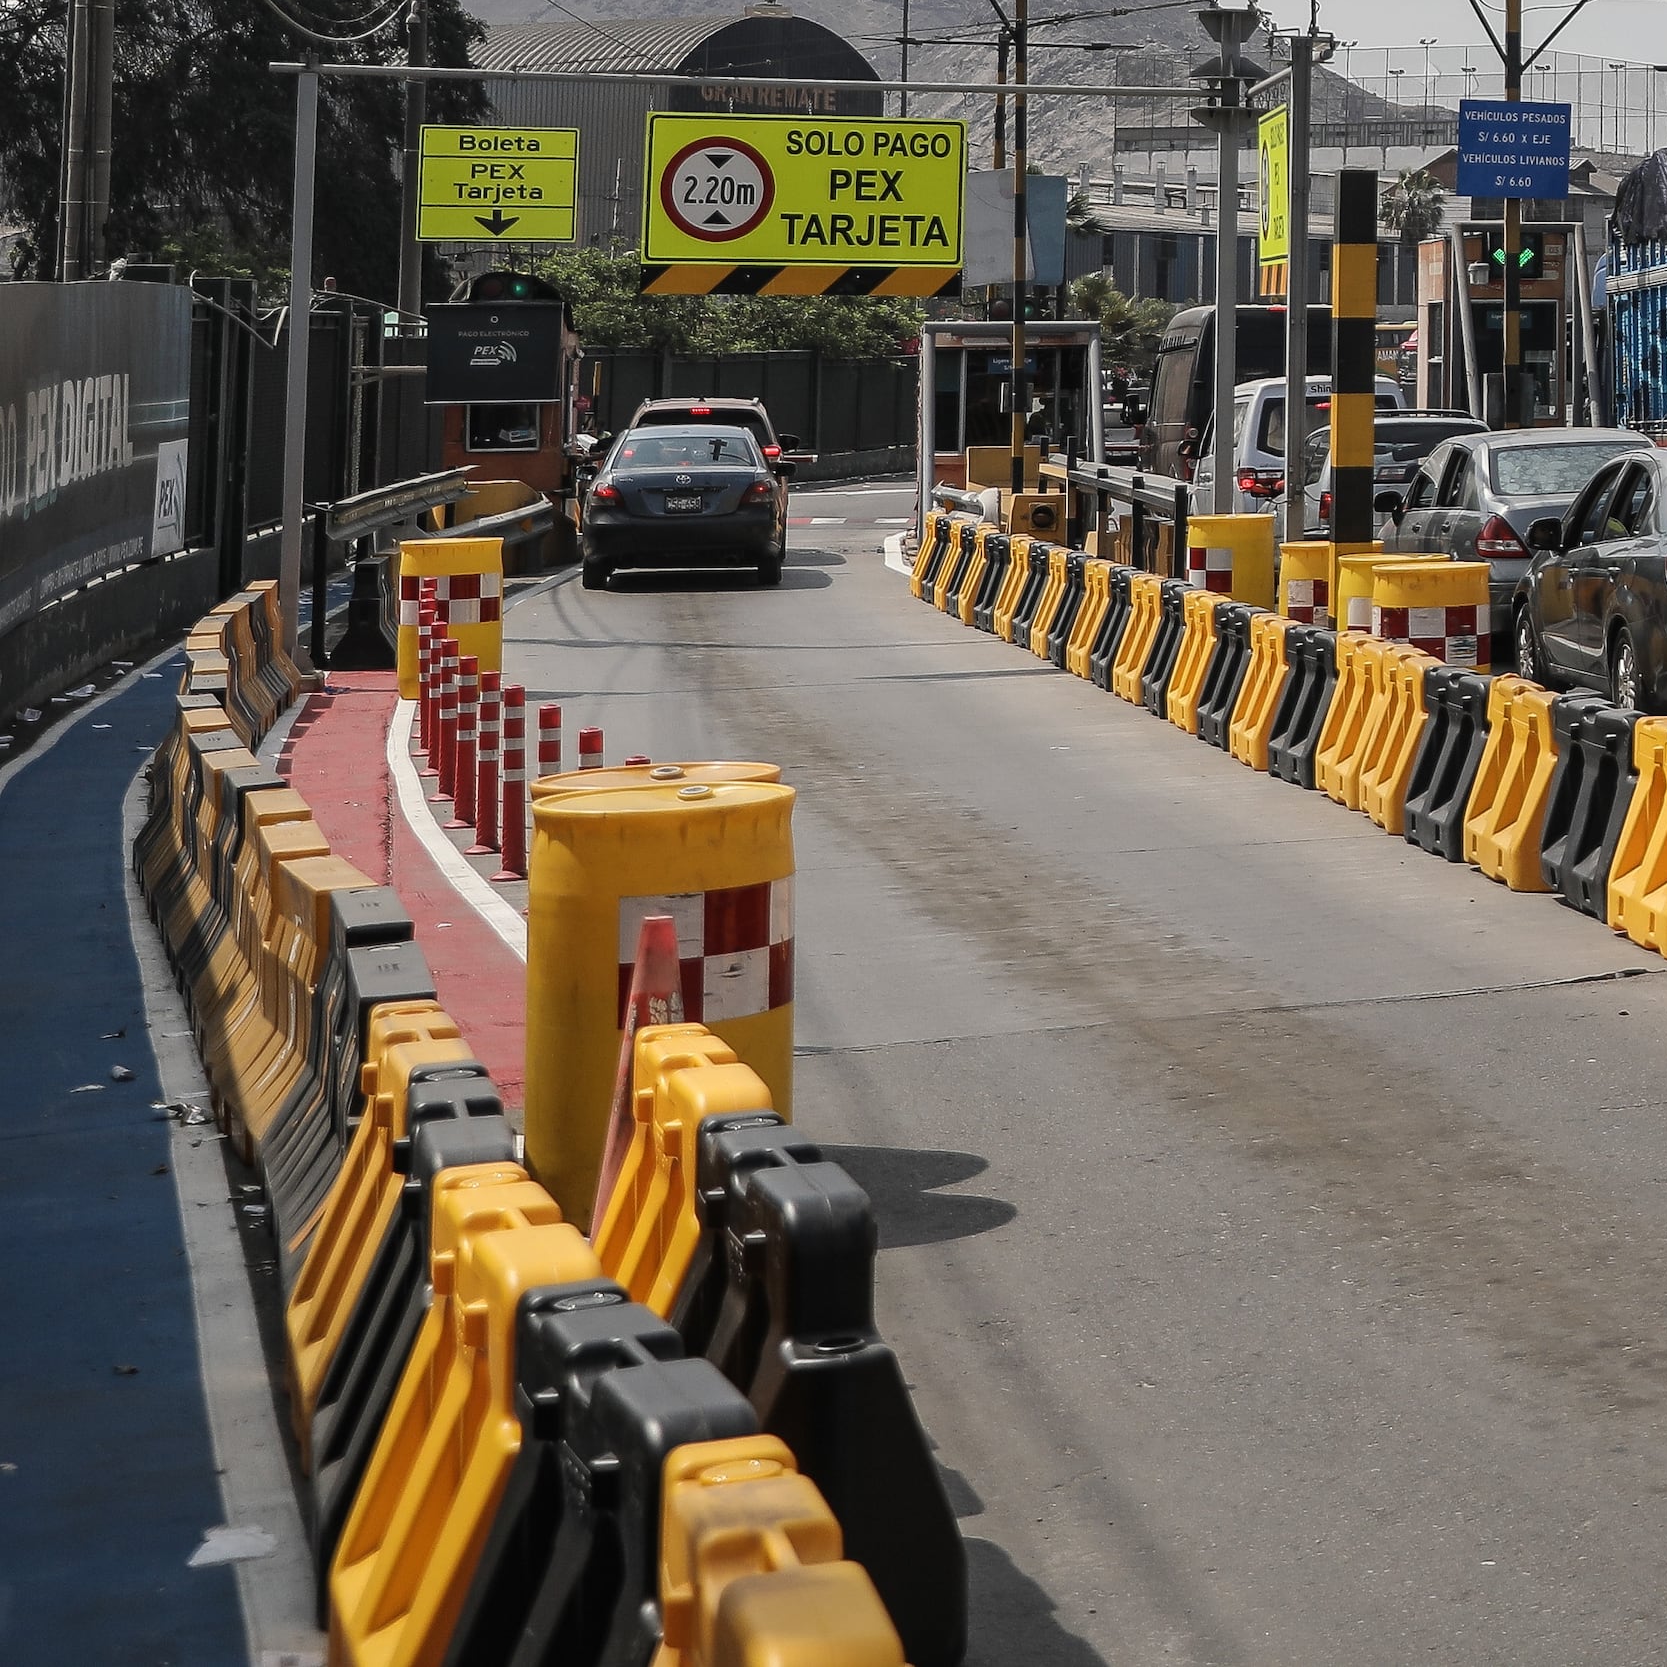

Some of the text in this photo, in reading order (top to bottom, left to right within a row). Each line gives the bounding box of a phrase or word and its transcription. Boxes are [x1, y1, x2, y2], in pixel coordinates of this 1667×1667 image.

[701, 85, 837, 111] GRAN REMATE
[1464, 109, 1566, 124] VEHÍCULOS PESADOS
[458, 134, 541, 152] Boleta
[786, 130, 951, 159] SOLO PAGO
[1478, 131, 1552, 145] S/ 6.60 X EJE
[1462, 152, 1566, 167] VEHÍCULOS LIVIANOS
[470, 163, 525, 180] PEX
[1495, 175, 1532, 188] S/ 6.60
[453, 182, 543, 205] Tarjeta
[683, 175, 756, 205] 2.20m
[829, 169, 904, 202] PEX
[780, 213, 950, 248] TARJETA
[474, 345, 499, 356] PEX
[26, 384, 60, 506] PEX
[58, 373, 133, 487] DIGITAL
[158, 477, 177, 519] PEX
